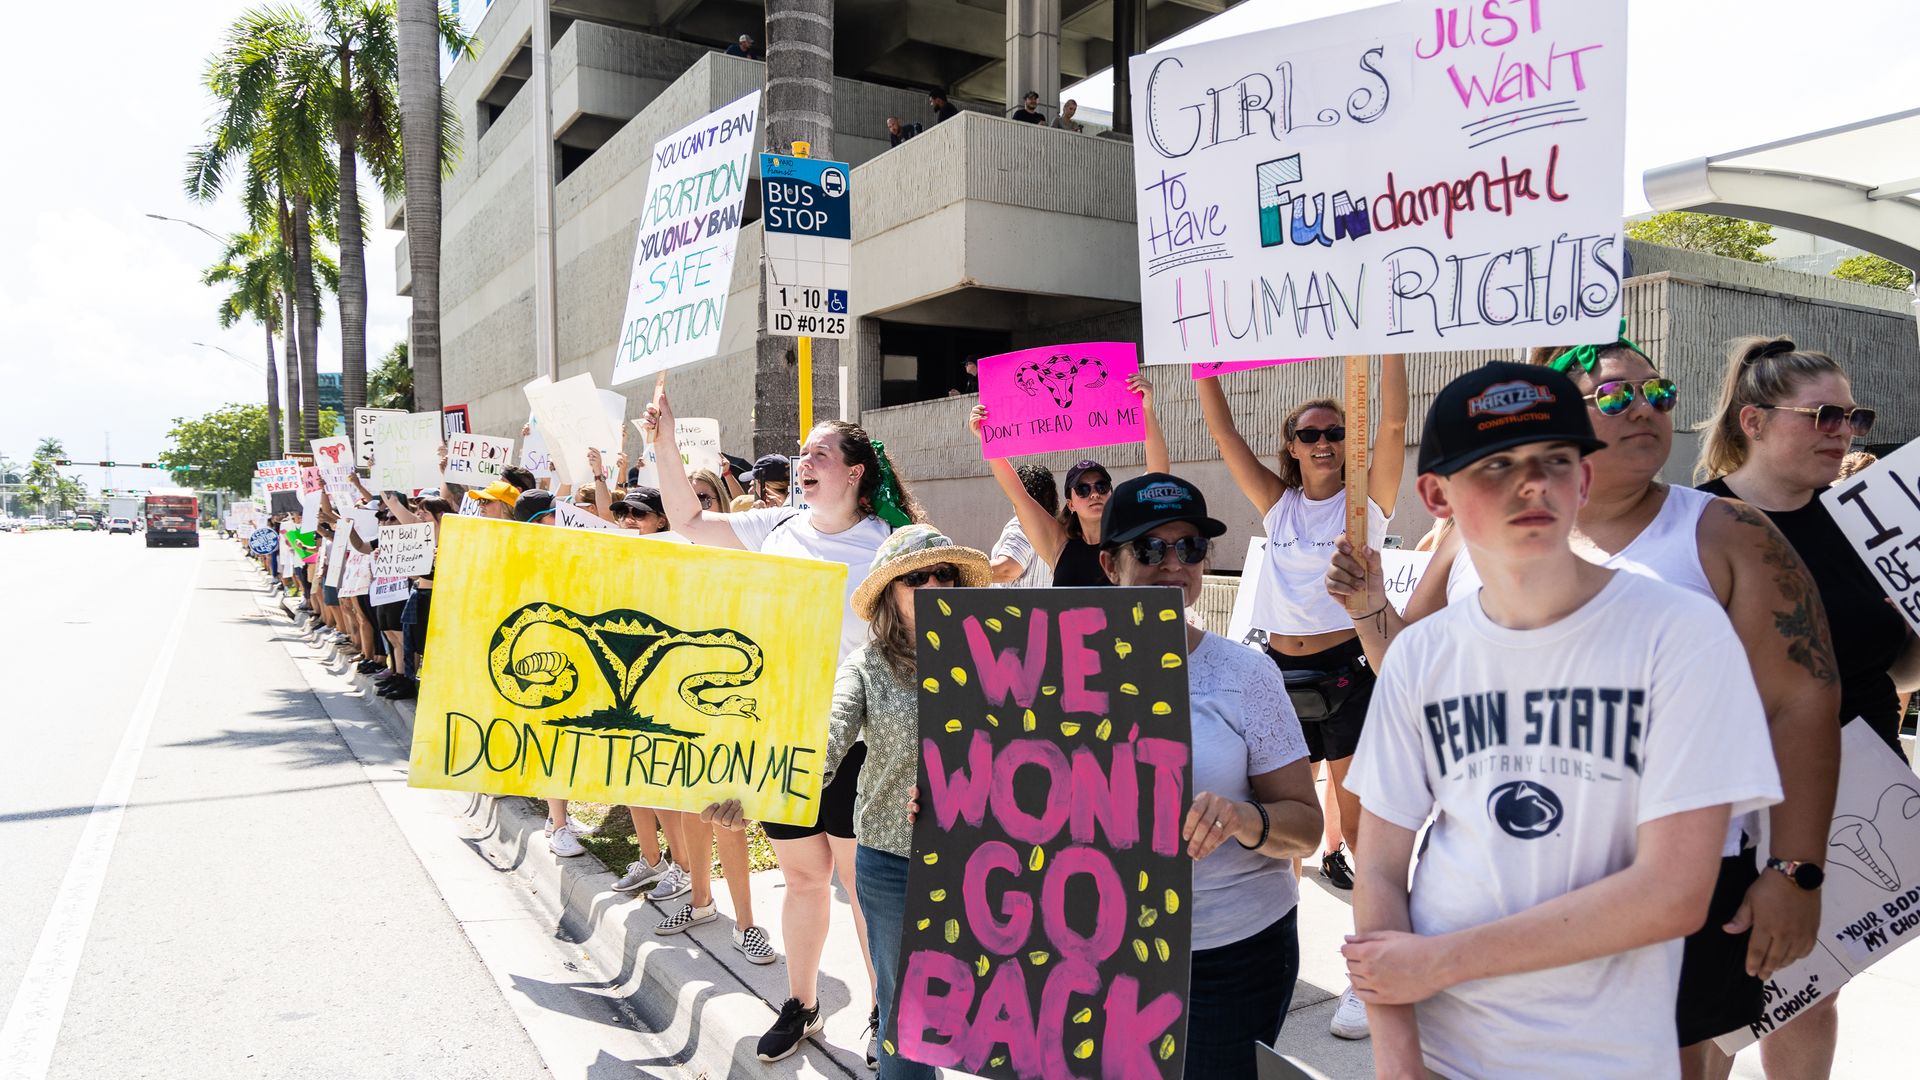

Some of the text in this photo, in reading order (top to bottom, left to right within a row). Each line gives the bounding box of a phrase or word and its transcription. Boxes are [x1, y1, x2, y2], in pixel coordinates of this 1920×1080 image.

[1416, 0, 1543, 59] JUST
[1146, 46, 1390, 158] GIRLS
[656, 110, 754, 172] YOU CAN'T BAN
[641, 153, 747, 230] ABORTION
[768, 182, 814, 206] BUS
[639, 200, 743, 266] YOU ONLY BAN
[769, 206, 828, 231] STOP
[645, 246, 718, 304] SAFE
[1172, 232, 1620, 350] HUMAN RIGHTS
[780, 287, 821, 309] 1 10
[616, 294, 726, 367] ABORTION
[775, 314, 845, 335] ID #0125
[983, 406, 1139, 443] DON'T TREAD ON ME
[1357, 373, 1366, 470] THE HOME DEPOT
[1478, 412, 1551, 430] CONSTRUCTION
[450, 459, 473, 473] HER
[453, 441, 509, 463] HER BODY
[259, 466, 297, 477] BELIEFS
[266, 482, 299, 491] BRIEFS
[379, 543, 393, 554] MY
[380, 528, 394, 540] MY
[375, 565, 391, 575] MY
[377, 555, 393, 565] MY
[962, 607, 1109, 715] WE
[1424, 687, 1646, 779] PENN STATE
[444, 712, 817, 800] DON'T TREAD ON ME
[922, 722, 1189, 857] WON'T
[962, 840, 1127, 963] GO
[1863, 927, 1889, 952] MY
[897, 949, 1182, 1080] BACK
[1749, 1013, 1775, 1039] MY
